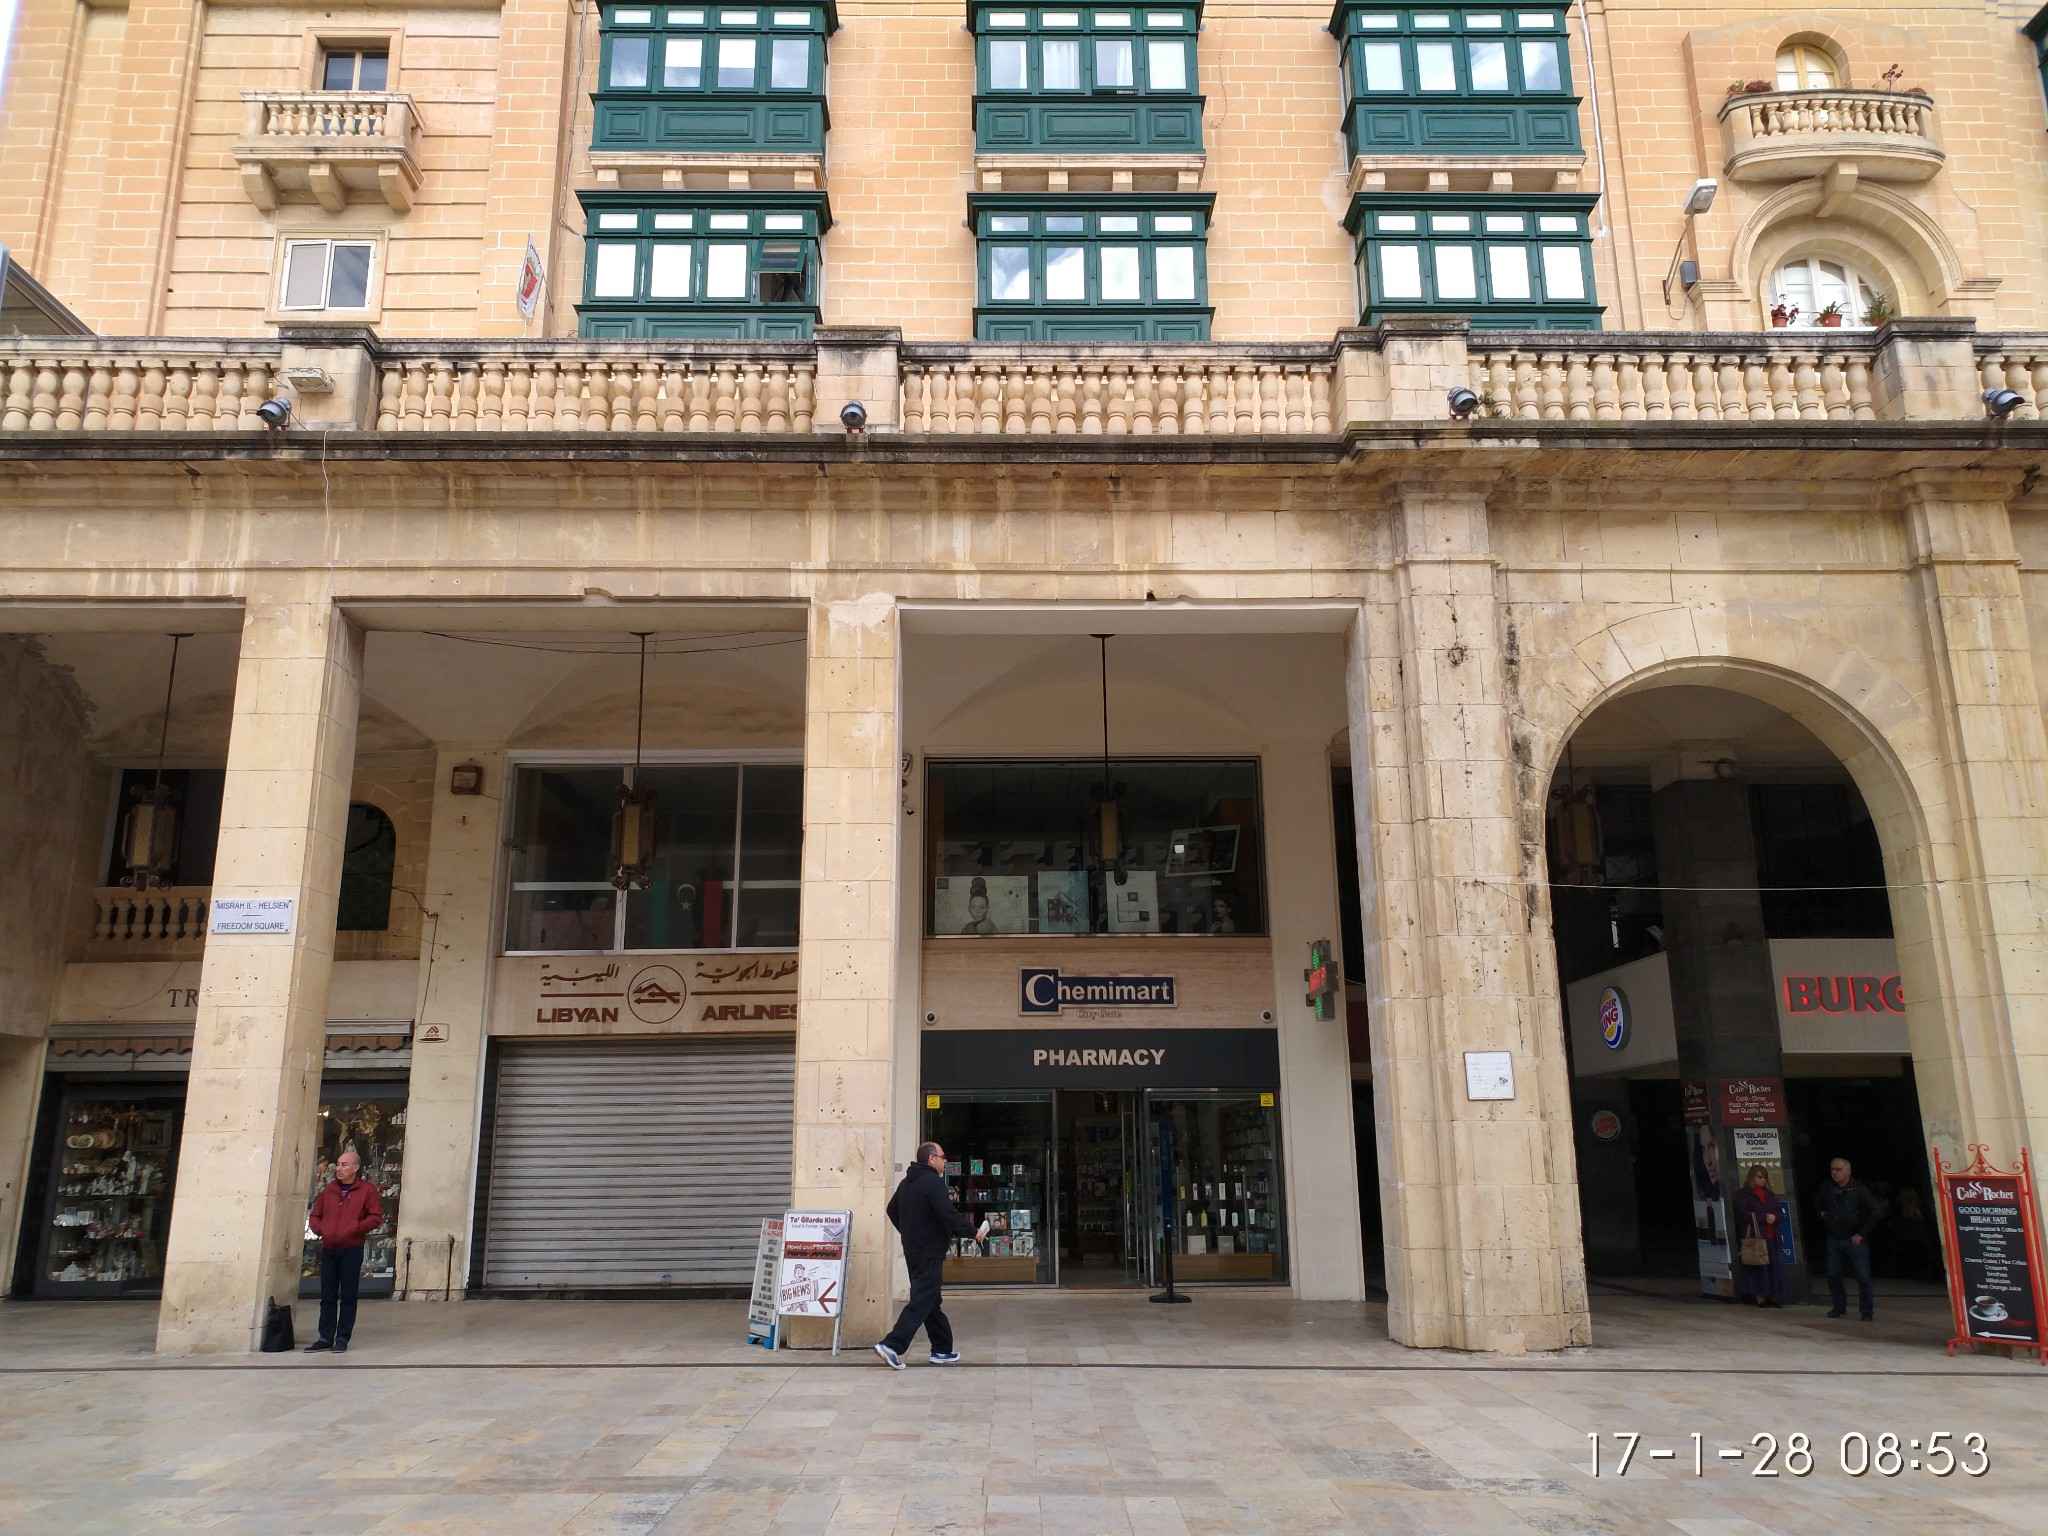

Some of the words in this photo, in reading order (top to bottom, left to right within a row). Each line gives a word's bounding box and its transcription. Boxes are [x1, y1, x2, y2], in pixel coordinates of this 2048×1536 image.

[217, 922, 253, 930] FREEDOM
[254, 922, 285, 930] SQUARE
[1025, 973, 1170, 1006] Chemimart
[537, 1007, 619, 1023] LIBYAN
[1033, 1049, 1166, 1066] PHARMACY
[1982, 1186, 2014, 1201] Rocher
[1958, 1206, 1981, 1215] GOOD
[1981, 1206, 2018, 1216] MORNING
[781, 1289, 793, 1302] BIG
[792, 1283, 811, 1298] NEWS
